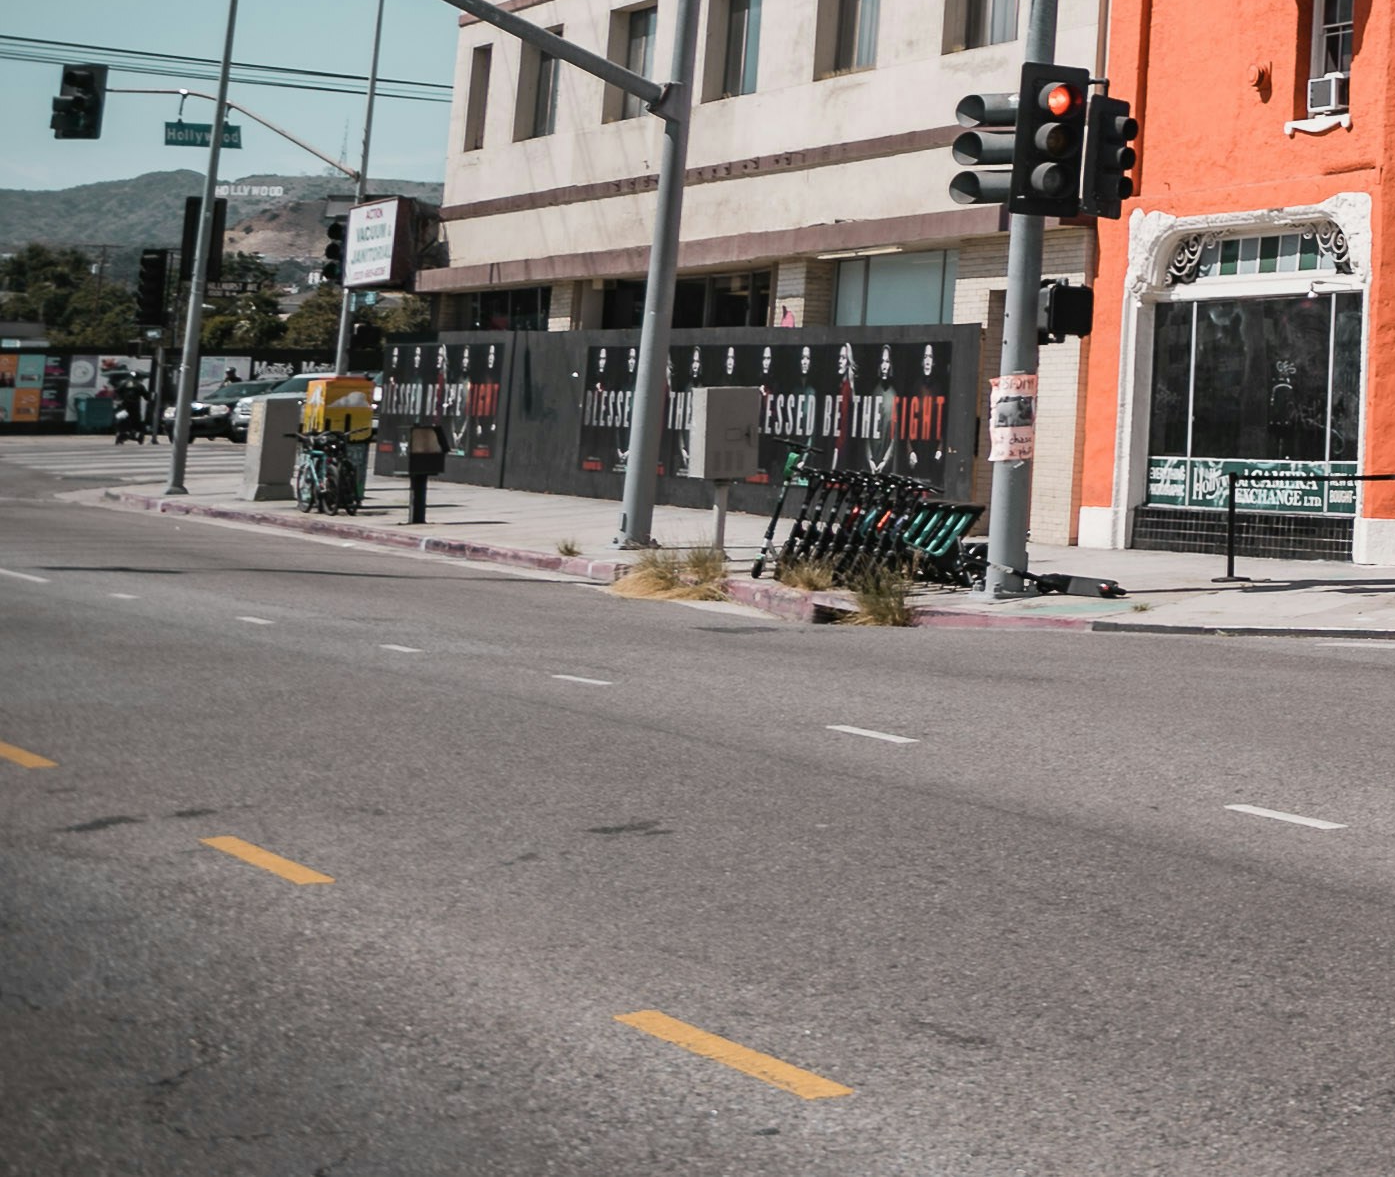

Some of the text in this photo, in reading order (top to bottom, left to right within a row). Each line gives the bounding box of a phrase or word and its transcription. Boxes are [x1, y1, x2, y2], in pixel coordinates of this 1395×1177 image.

[166, 127, 239, 143] Hollywod
[215, 185, 283, 197] HOLLYWOOD
[584, 390, 635, 427] BLESSE
[758, 394, 945, 440] ESSED BE THE FIGHT
[1235, 488, 1303, 507] EXCHANGE
